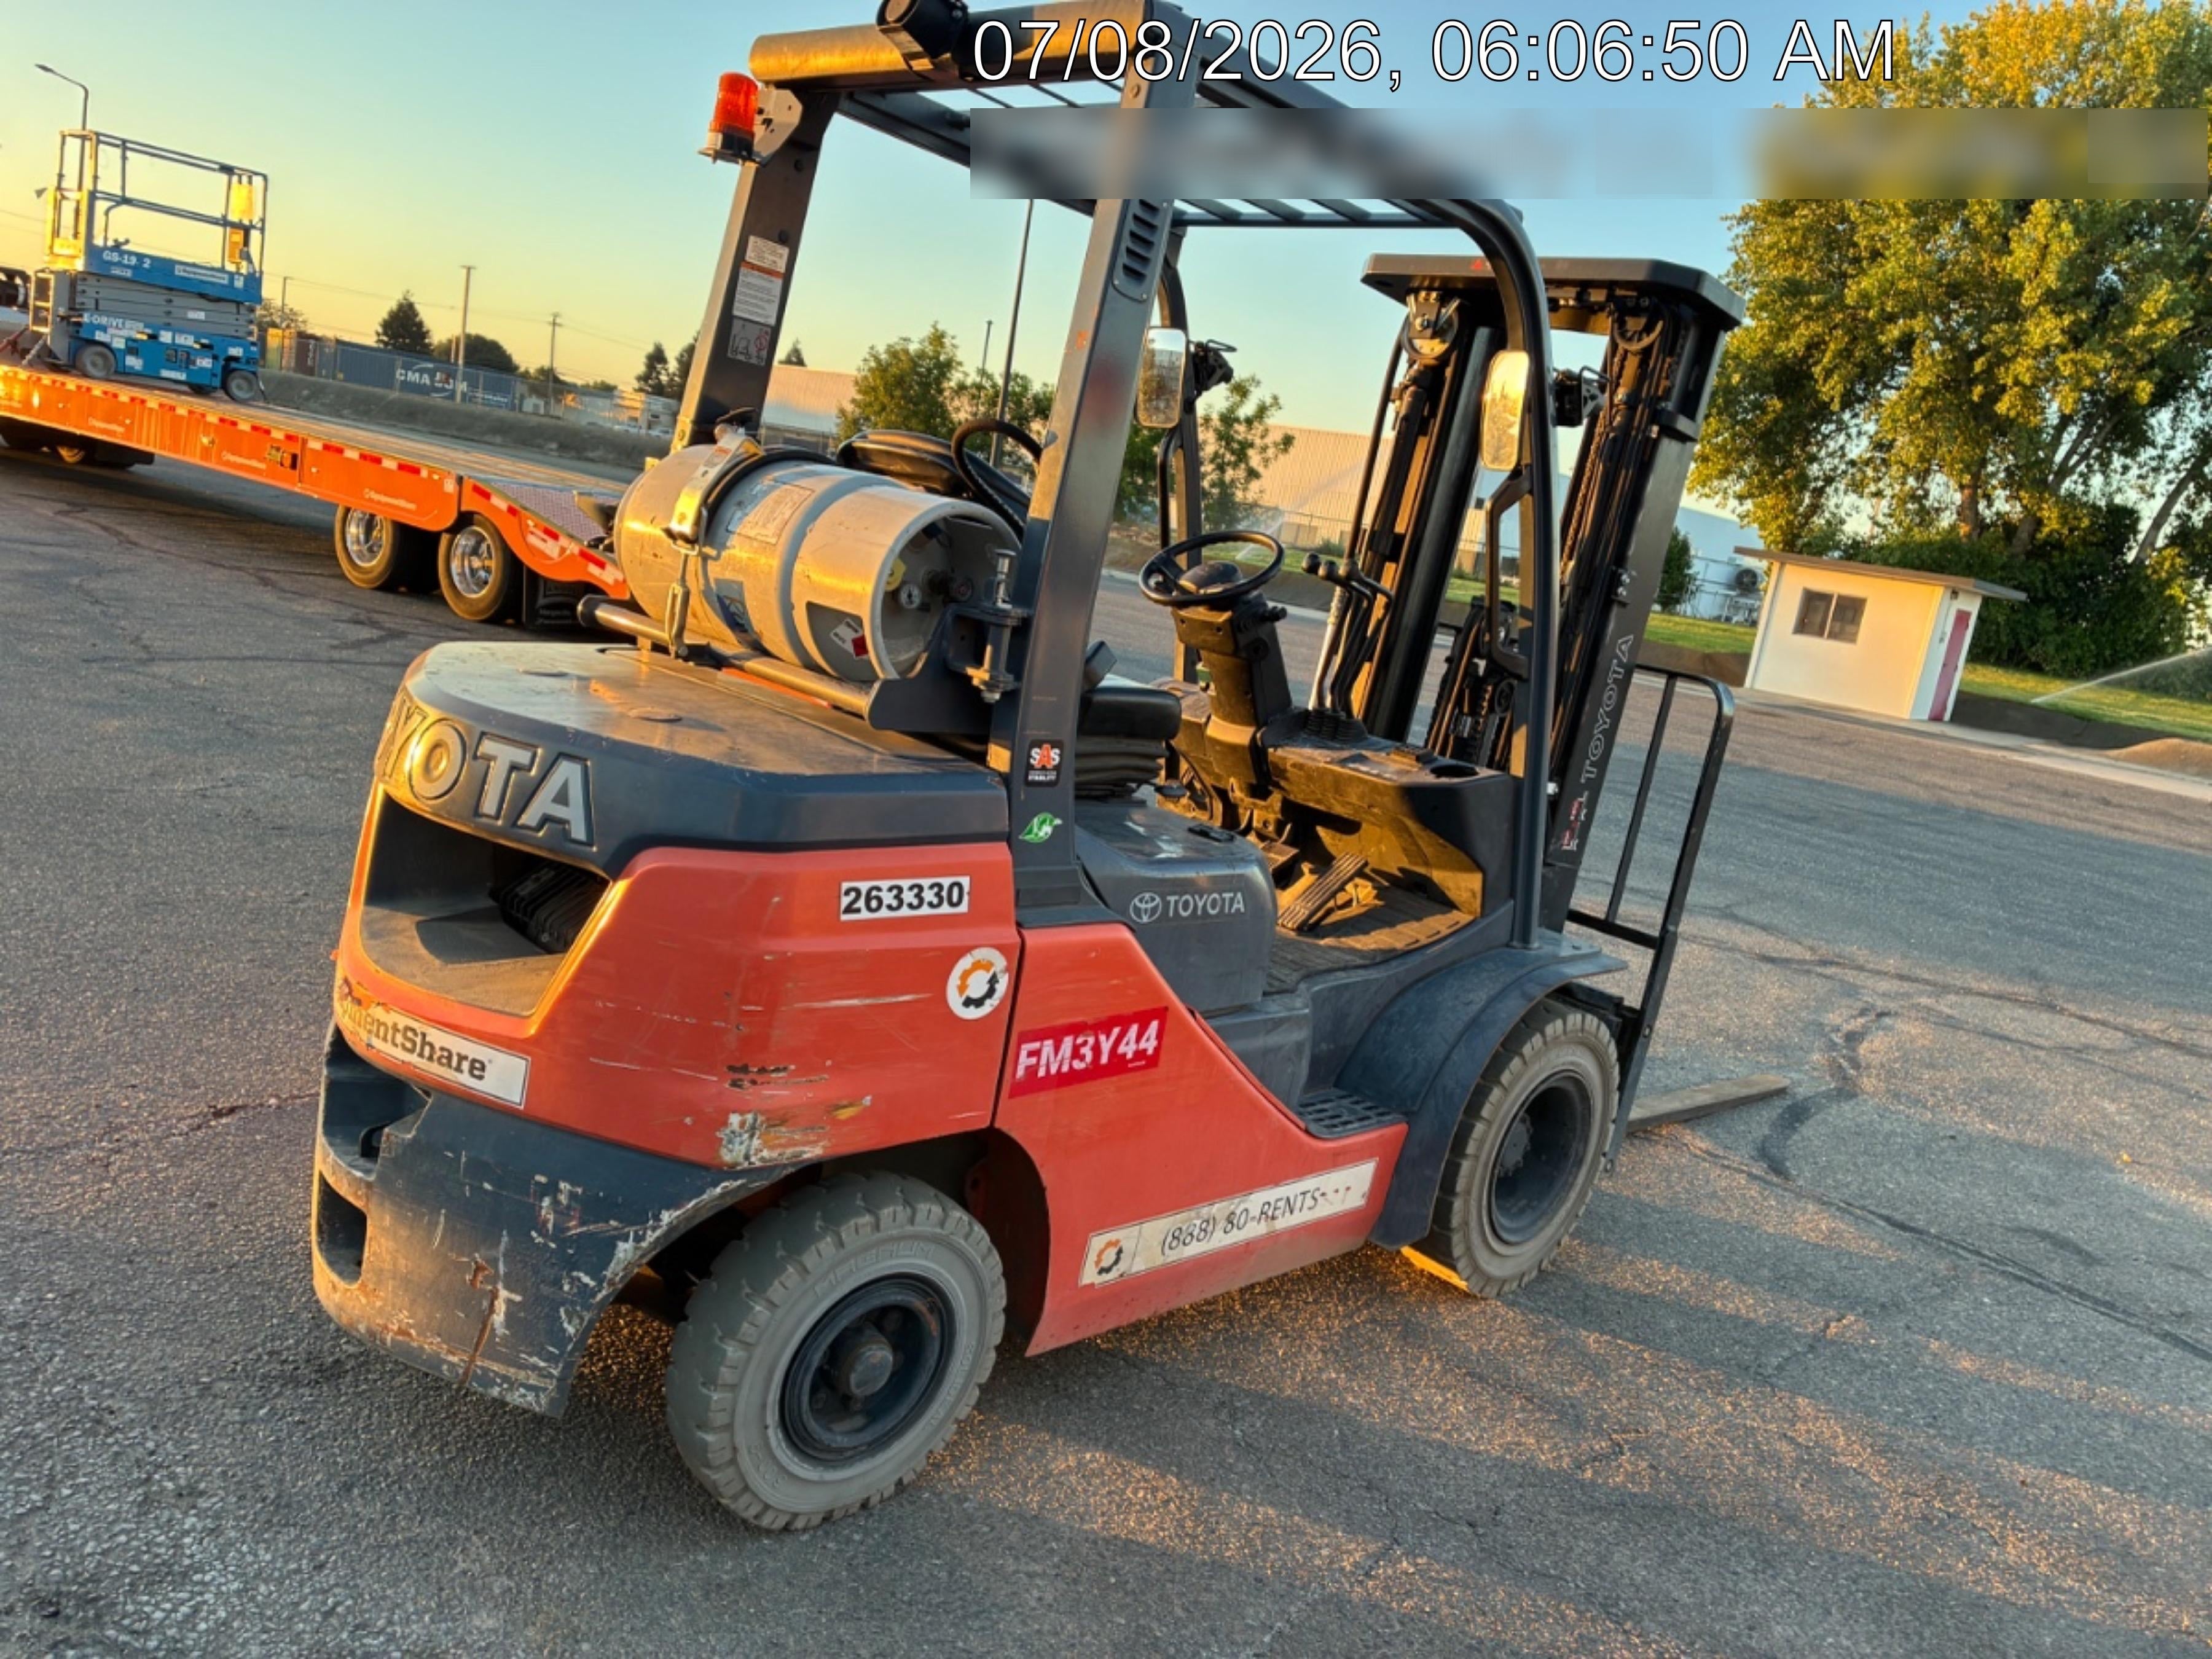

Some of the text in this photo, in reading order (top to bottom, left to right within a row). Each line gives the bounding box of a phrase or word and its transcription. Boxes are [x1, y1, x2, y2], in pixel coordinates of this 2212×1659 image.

[103, 250, 151, 269] GS-192
[396, 369, 430, 386] CMA
[1581, 633, 1634, 784] TOYOTA
[1029, 743, 1061, 769] SAS
[380, 697, 597, 852] YOTA
[842, 880, 965, 914] 263330
[1166, 892, 1245, 917] TOYOTA
[1015, 1019, 1160, 1080] FM3Y44
[1161, 1186, 1321, 1256] (888) 80-RENTS
